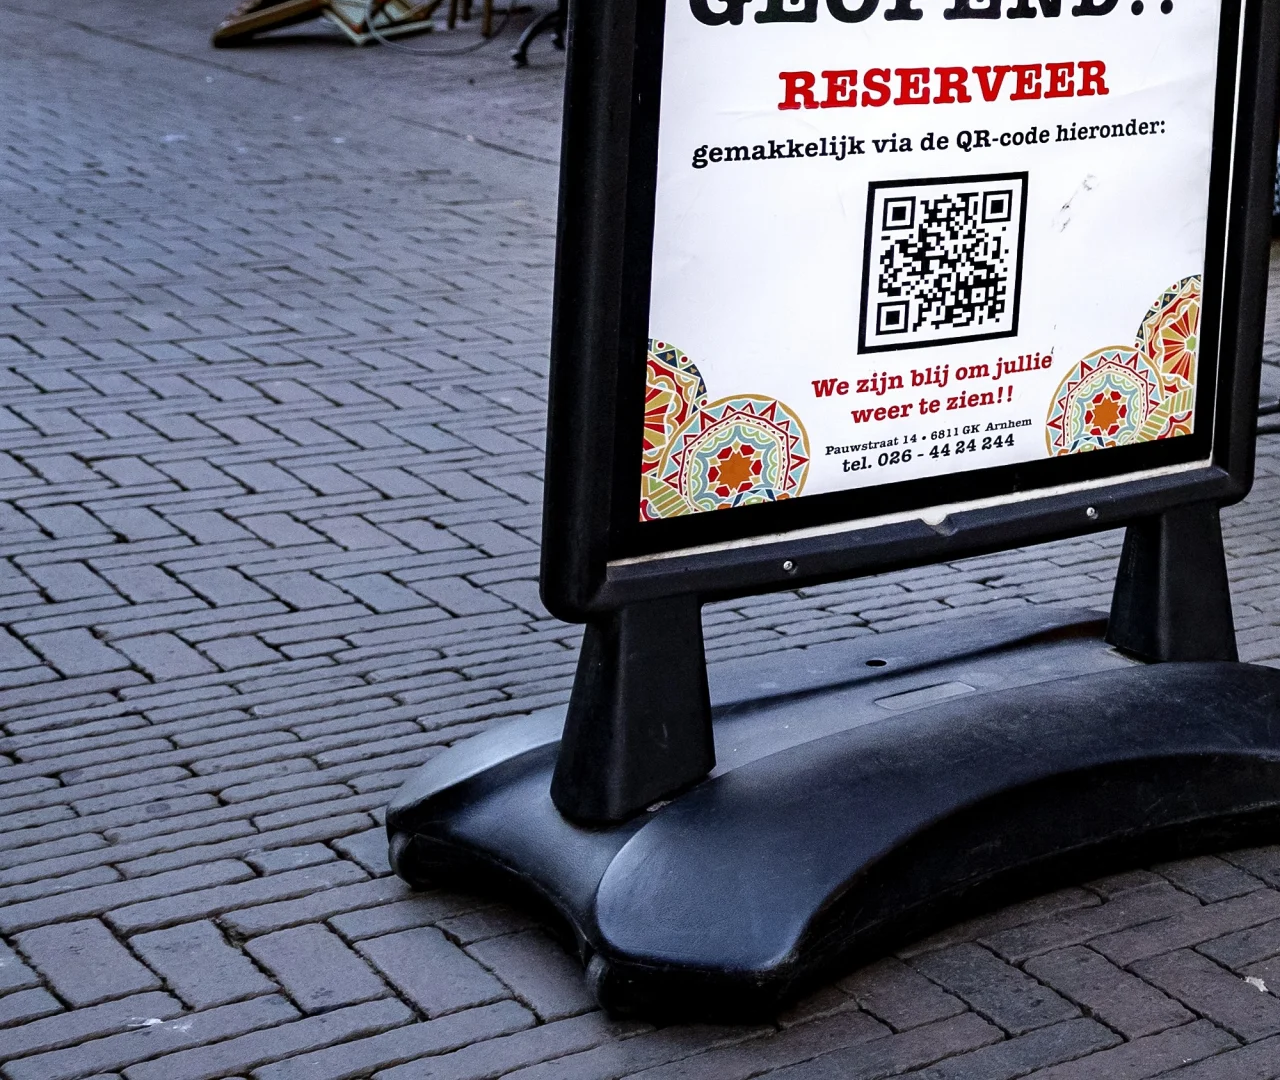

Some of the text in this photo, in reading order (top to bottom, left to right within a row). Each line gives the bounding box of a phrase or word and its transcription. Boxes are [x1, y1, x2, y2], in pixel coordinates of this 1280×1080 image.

[778, 60, 1109, 110] RESERVEER
[692, 119, 1165, 169] gemakkelijk via de QR-code hieronder:
[812, 352, 1052, 397] We zijn blij om jullie
[851, 386, 1013, 423] weer te zien!!
[825, 418, 1032, 456] Pauwstraat 14 6811 GK Arnhem
[843, 457, 872, 472] tel.
[878, 449, 912, 466] 026
[929, 444, 951, 459] 44
[956, 439, 977, 454] 24
[982, 434, 1014, 451] 244
